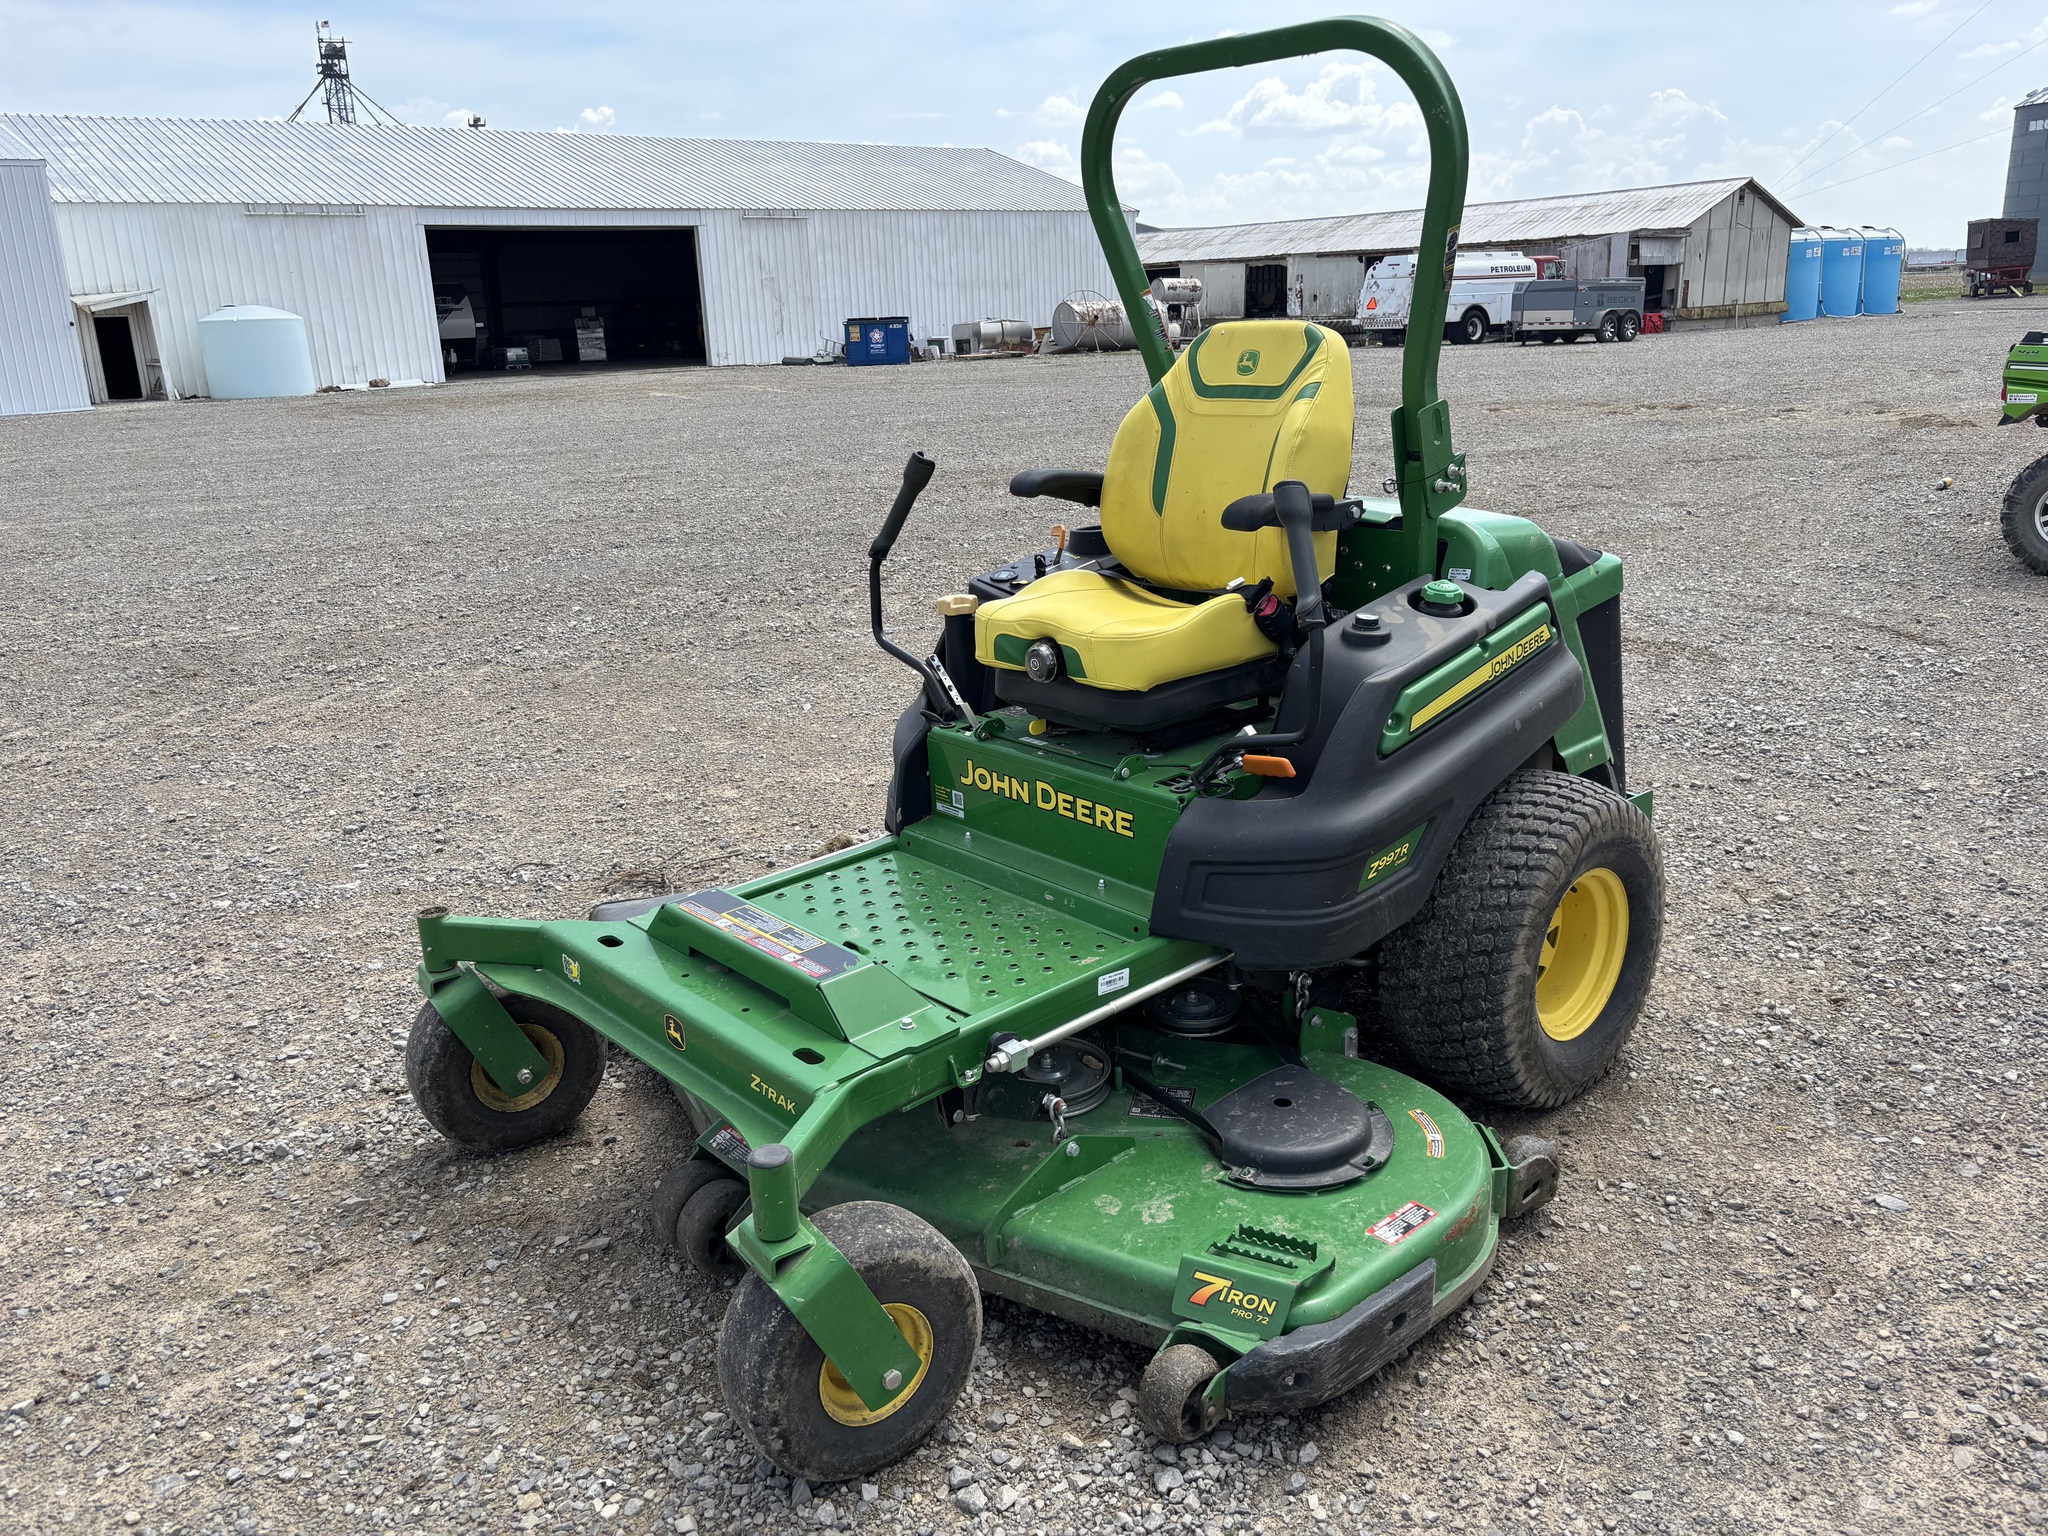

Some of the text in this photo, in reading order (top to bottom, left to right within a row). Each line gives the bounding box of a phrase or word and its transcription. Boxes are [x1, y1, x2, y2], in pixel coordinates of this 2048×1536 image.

[1490, 264, 1532, 273] PETROLEUM
[1607, 296, 1636, 304] BECK'S
[1488, 630, 1545, 679] JOHN DEERE
[960, 758, 1135, 838] JOHN DEERE
[1368, 843, 1409, 880] Z997R
[751, 1073, 796, 1115] ZTRAK
[1189, 1271, 1277, 1315] 7 IRON
[1230, 1307, 1270, 1325] PRO 72
